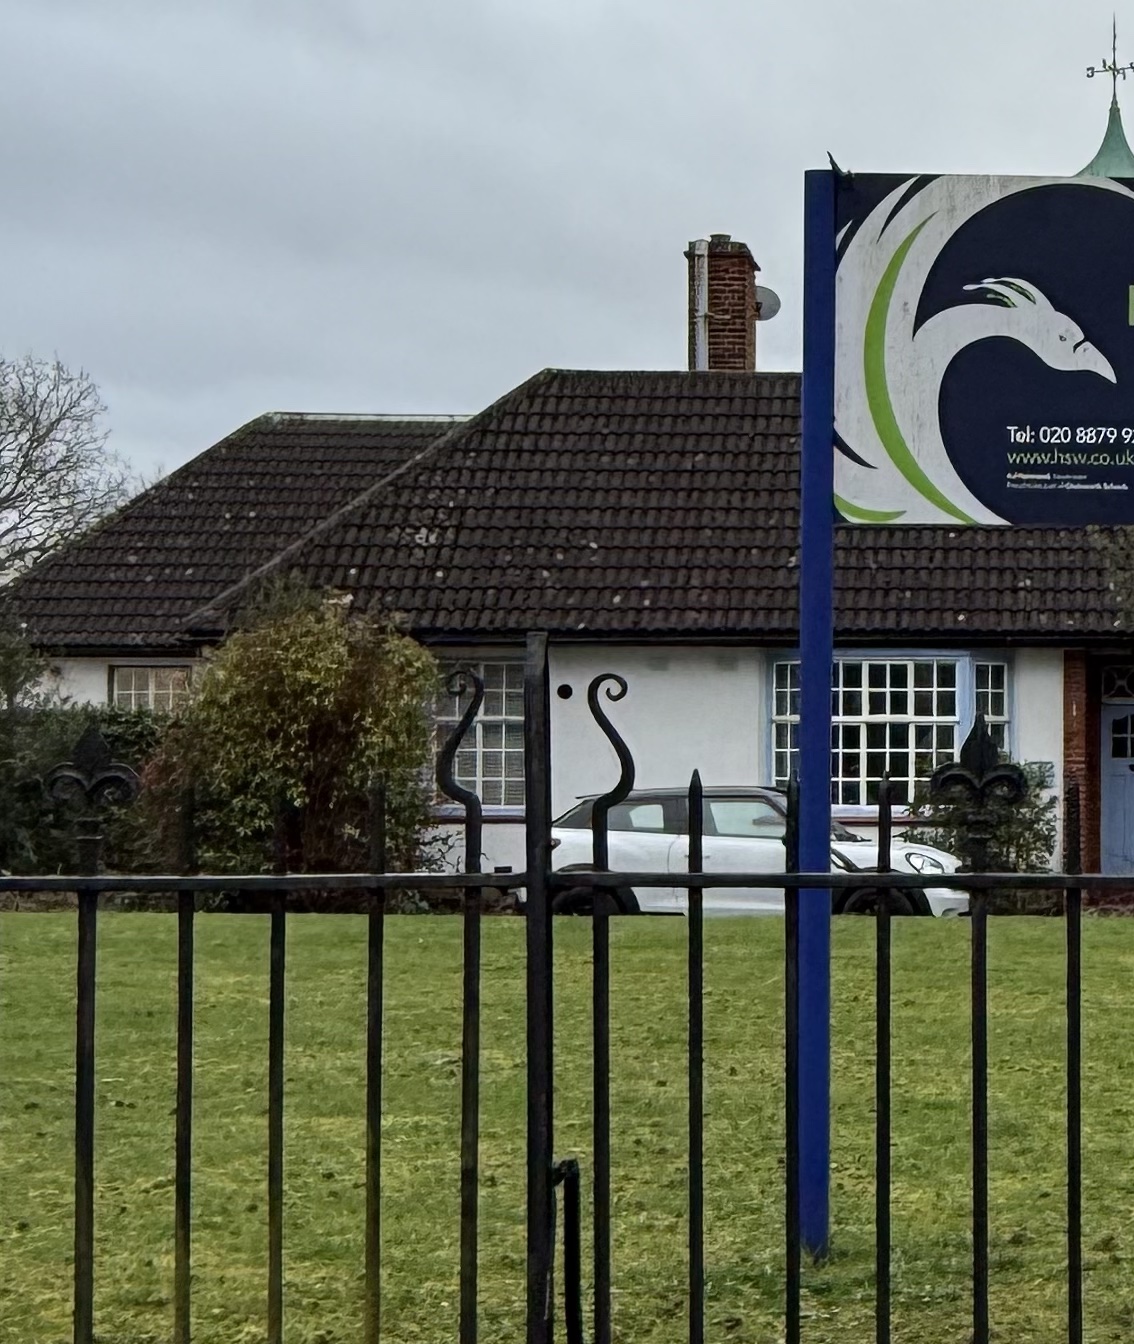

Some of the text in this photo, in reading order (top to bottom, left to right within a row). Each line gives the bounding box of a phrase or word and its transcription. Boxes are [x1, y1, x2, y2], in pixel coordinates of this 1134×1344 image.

[1006, 425, 1035, 444] Tel:
[1039, 426, 1071, 444] 020
[1076, 427, 1117, 444] 8879
